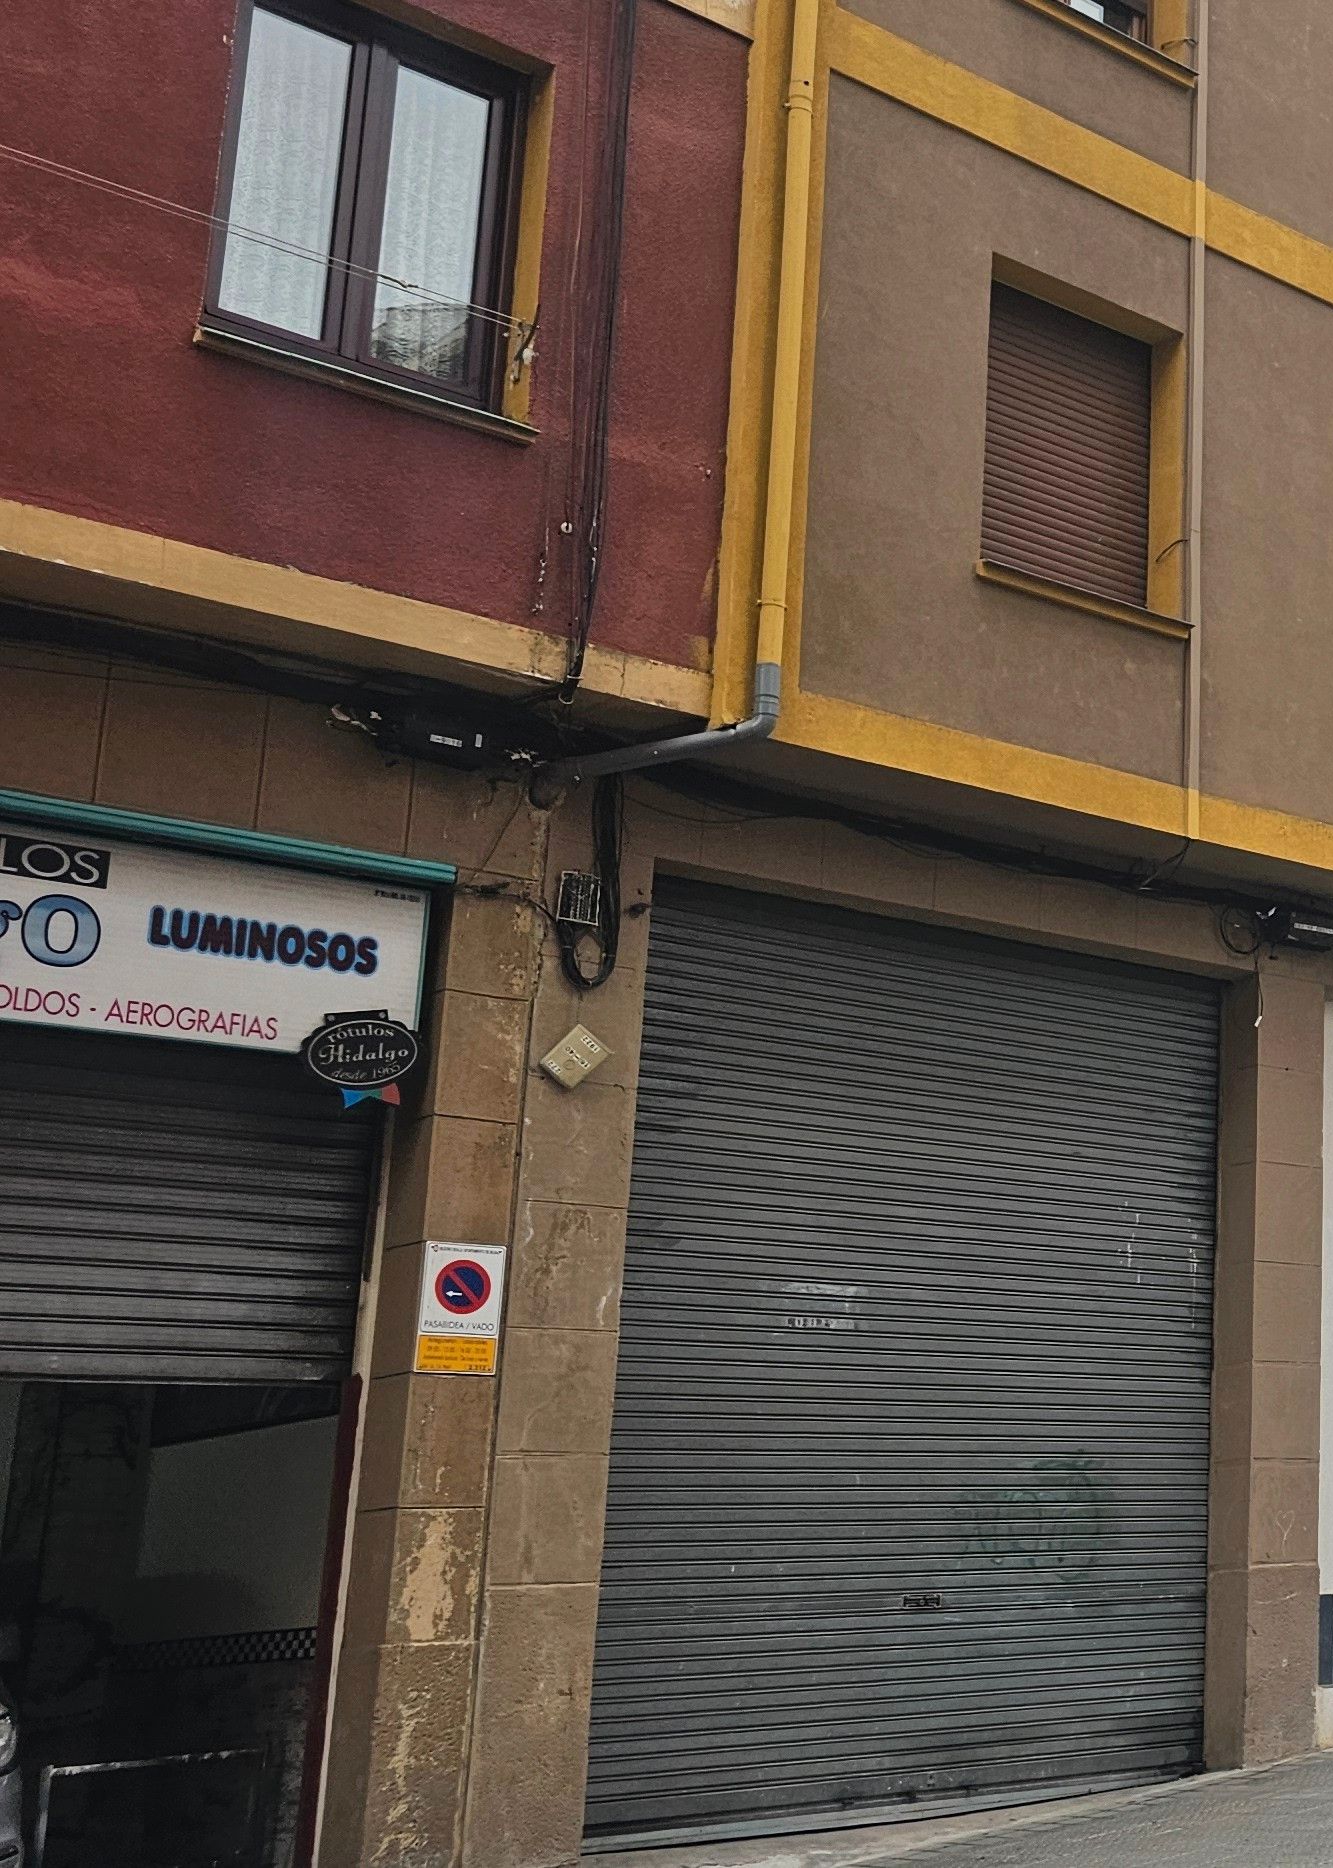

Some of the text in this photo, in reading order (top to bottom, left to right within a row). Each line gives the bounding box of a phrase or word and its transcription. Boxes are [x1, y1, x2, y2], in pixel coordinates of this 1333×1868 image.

[149, 905, 379, 976] LUMINOSOS
[104, 998, 279, 1041] AEROGRAFIAS
[318, 1042, 409, 1065] Hidalgo
[472, 1322, 495, 1332] VADO
